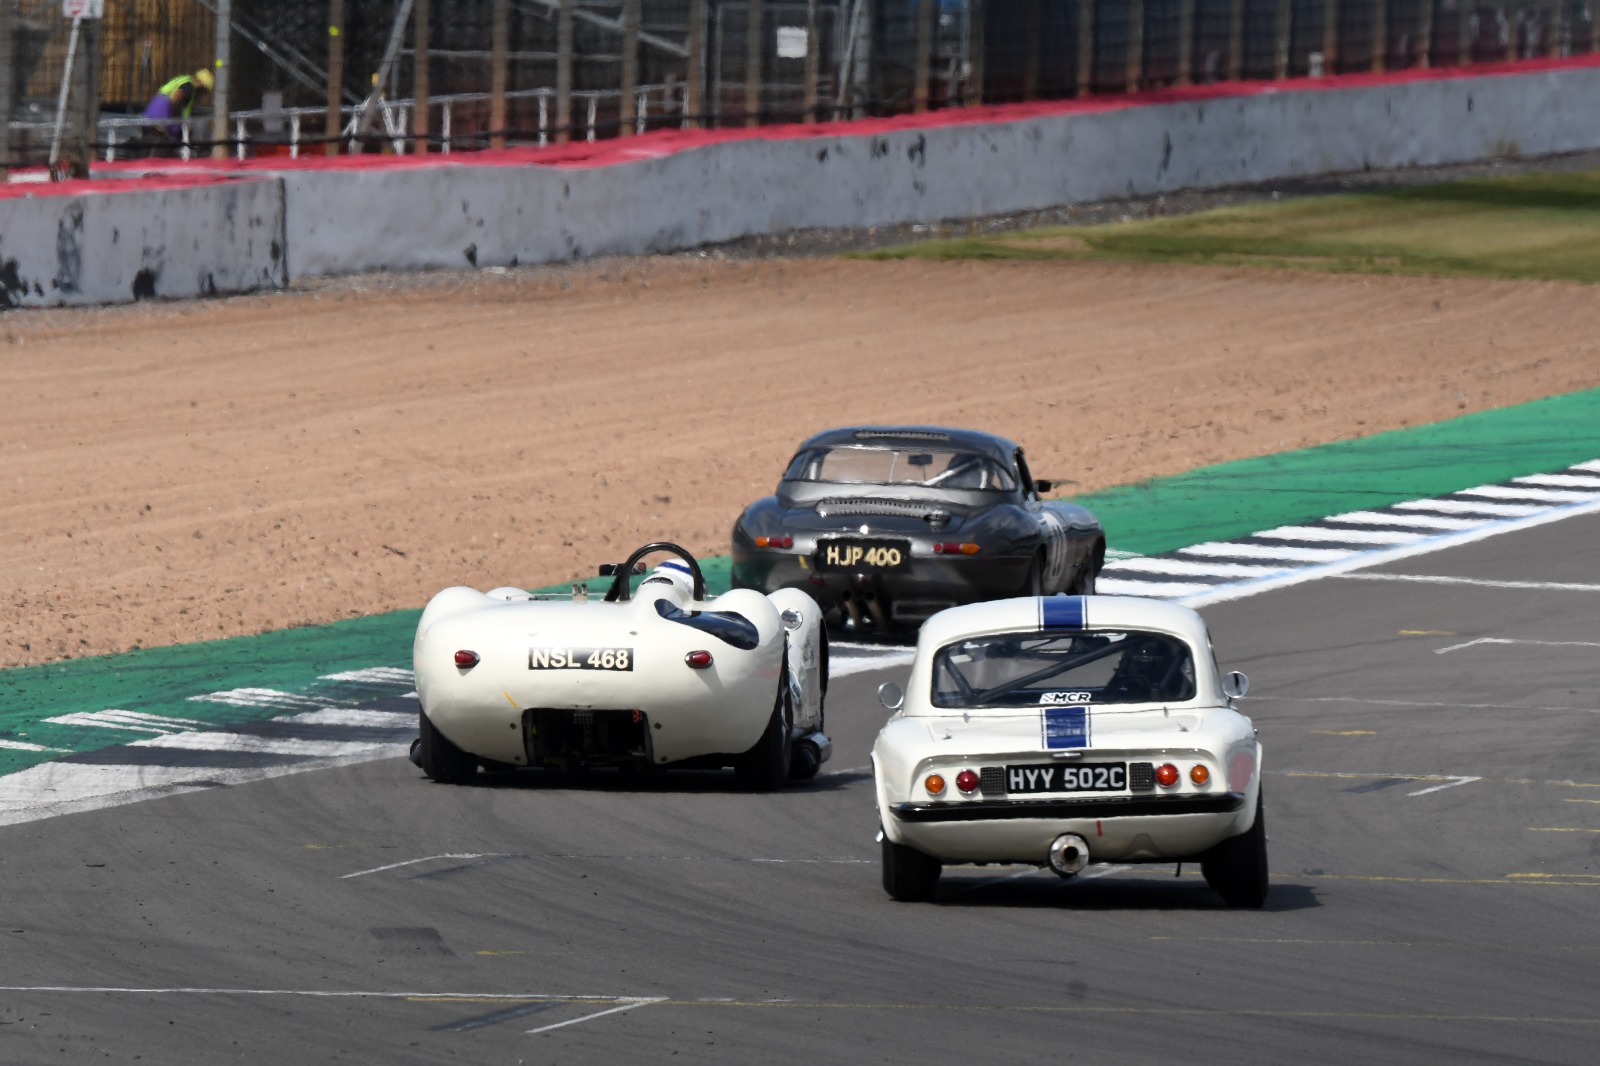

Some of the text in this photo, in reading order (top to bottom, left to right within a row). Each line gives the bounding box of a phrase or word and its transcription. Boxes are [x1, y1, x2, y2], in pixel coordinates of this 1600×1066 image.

[827, 545, 901, 567] HJP 400
[532, 648, 629, 669] NSL 468
[1053, 693, 1090, 702] MCR
[1009, 767, 1124, 790] HYY 502C
